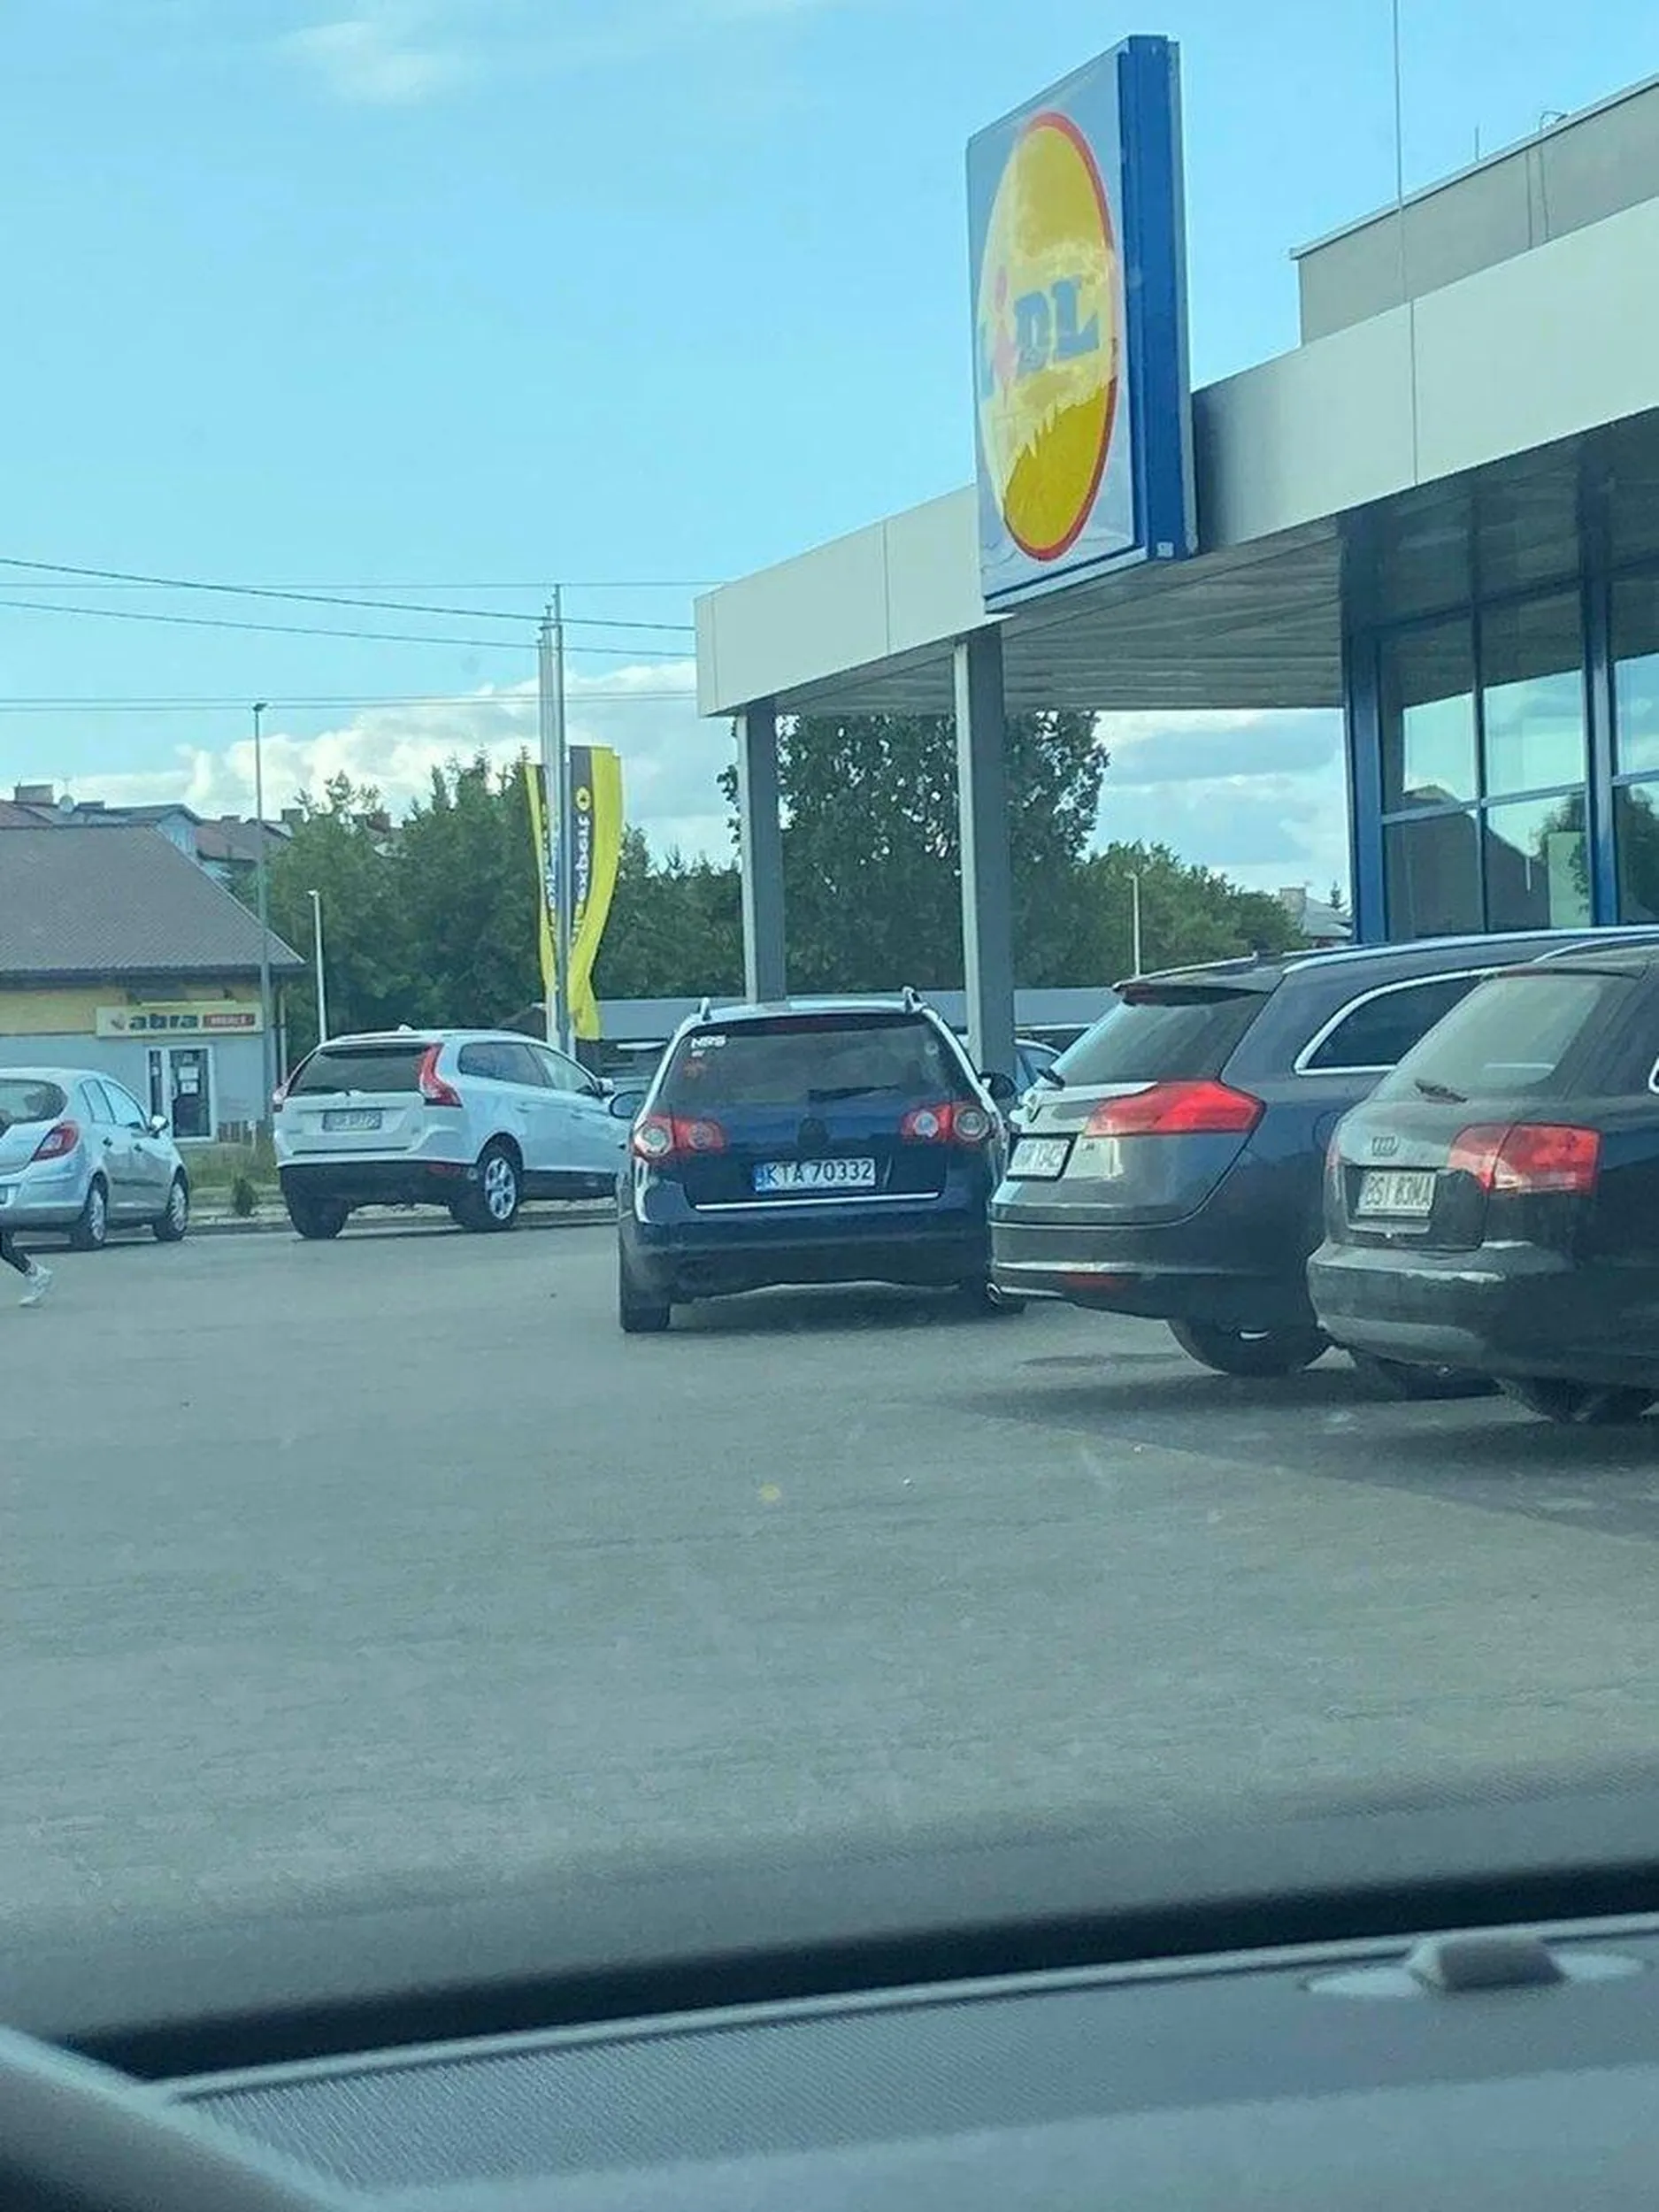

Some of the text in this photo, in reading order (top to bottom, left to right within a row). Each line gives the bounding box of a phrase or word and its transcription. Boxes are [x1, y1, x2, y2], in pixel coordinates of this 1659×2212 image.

[129, 1014, 199, 1029] abra
[766, 1161, 872, 1186] KTA 70332
